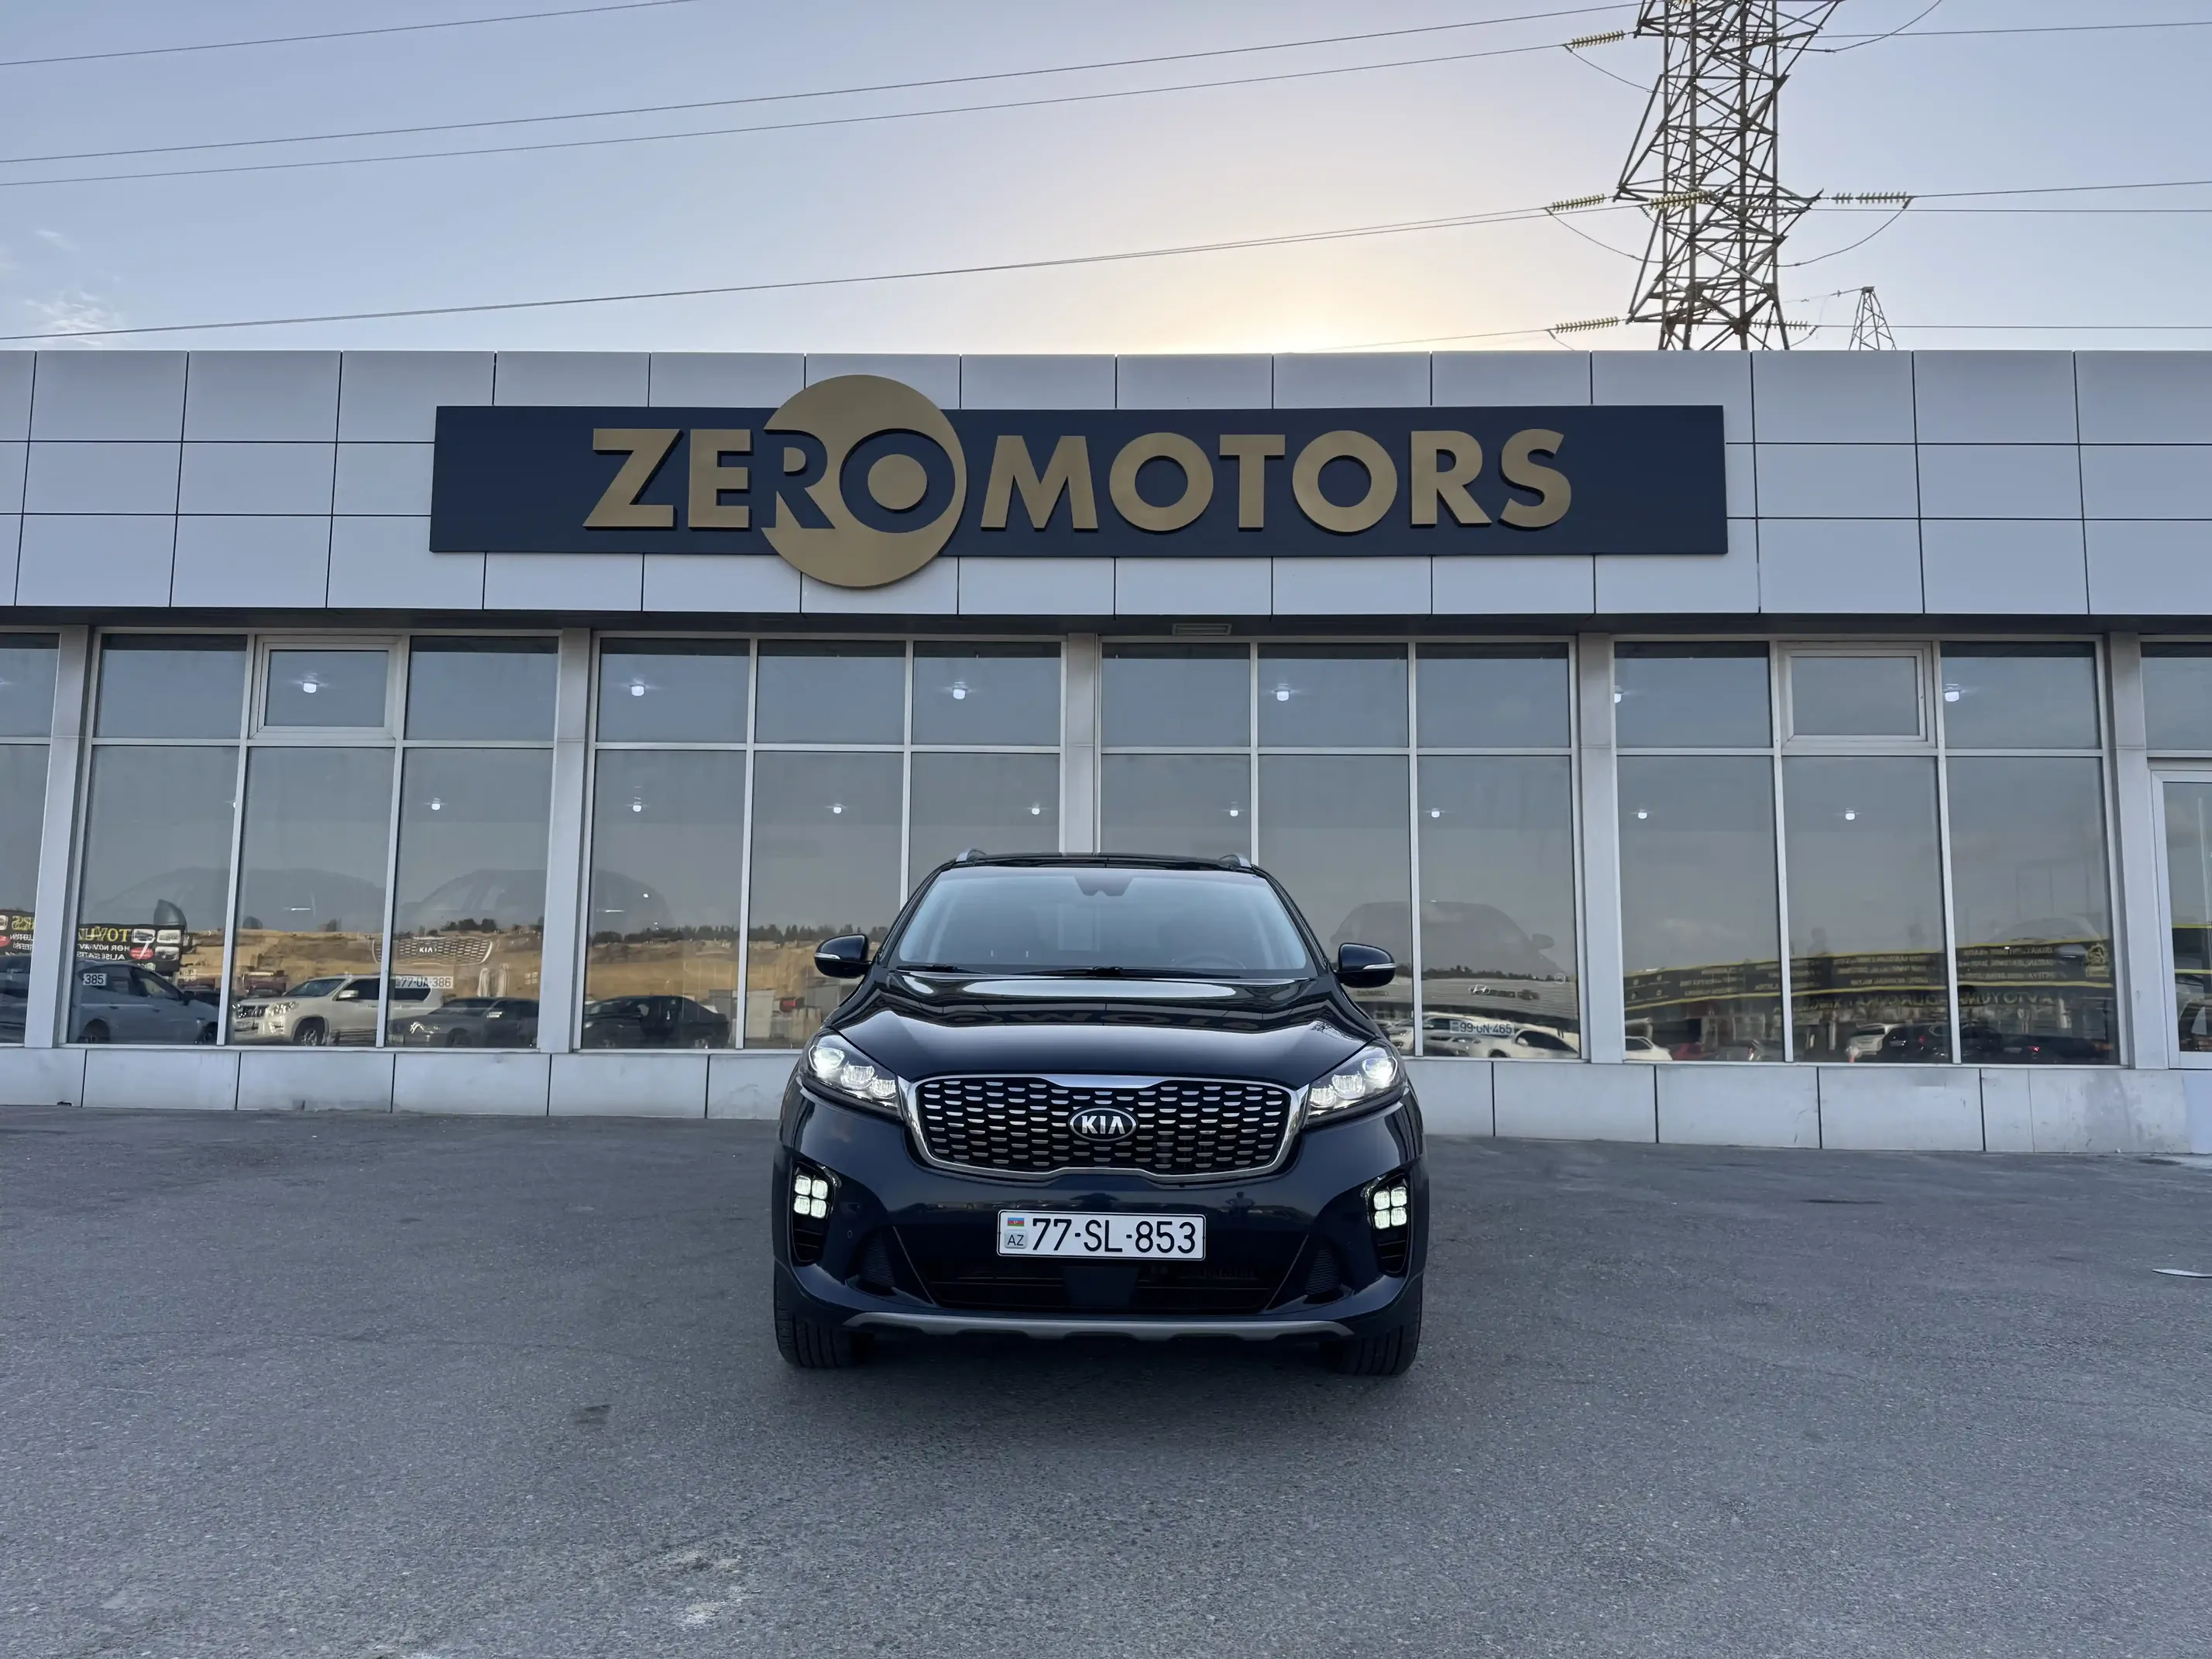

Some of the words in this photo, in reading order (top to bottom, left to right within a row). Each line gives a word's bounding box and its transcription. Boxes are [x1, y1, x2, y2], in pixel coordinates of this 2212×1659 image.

[582, 423, 964, 540] ZERO
[980, 428, 1571, 534] MOTORS
[85, 974, 104, 985] 385
[1081, 1115, 1126, 1135] KIA
[1007, 1234, 1024, 1246] AZ
[1032, 1218, 1196, 1254] 77-SL-853
